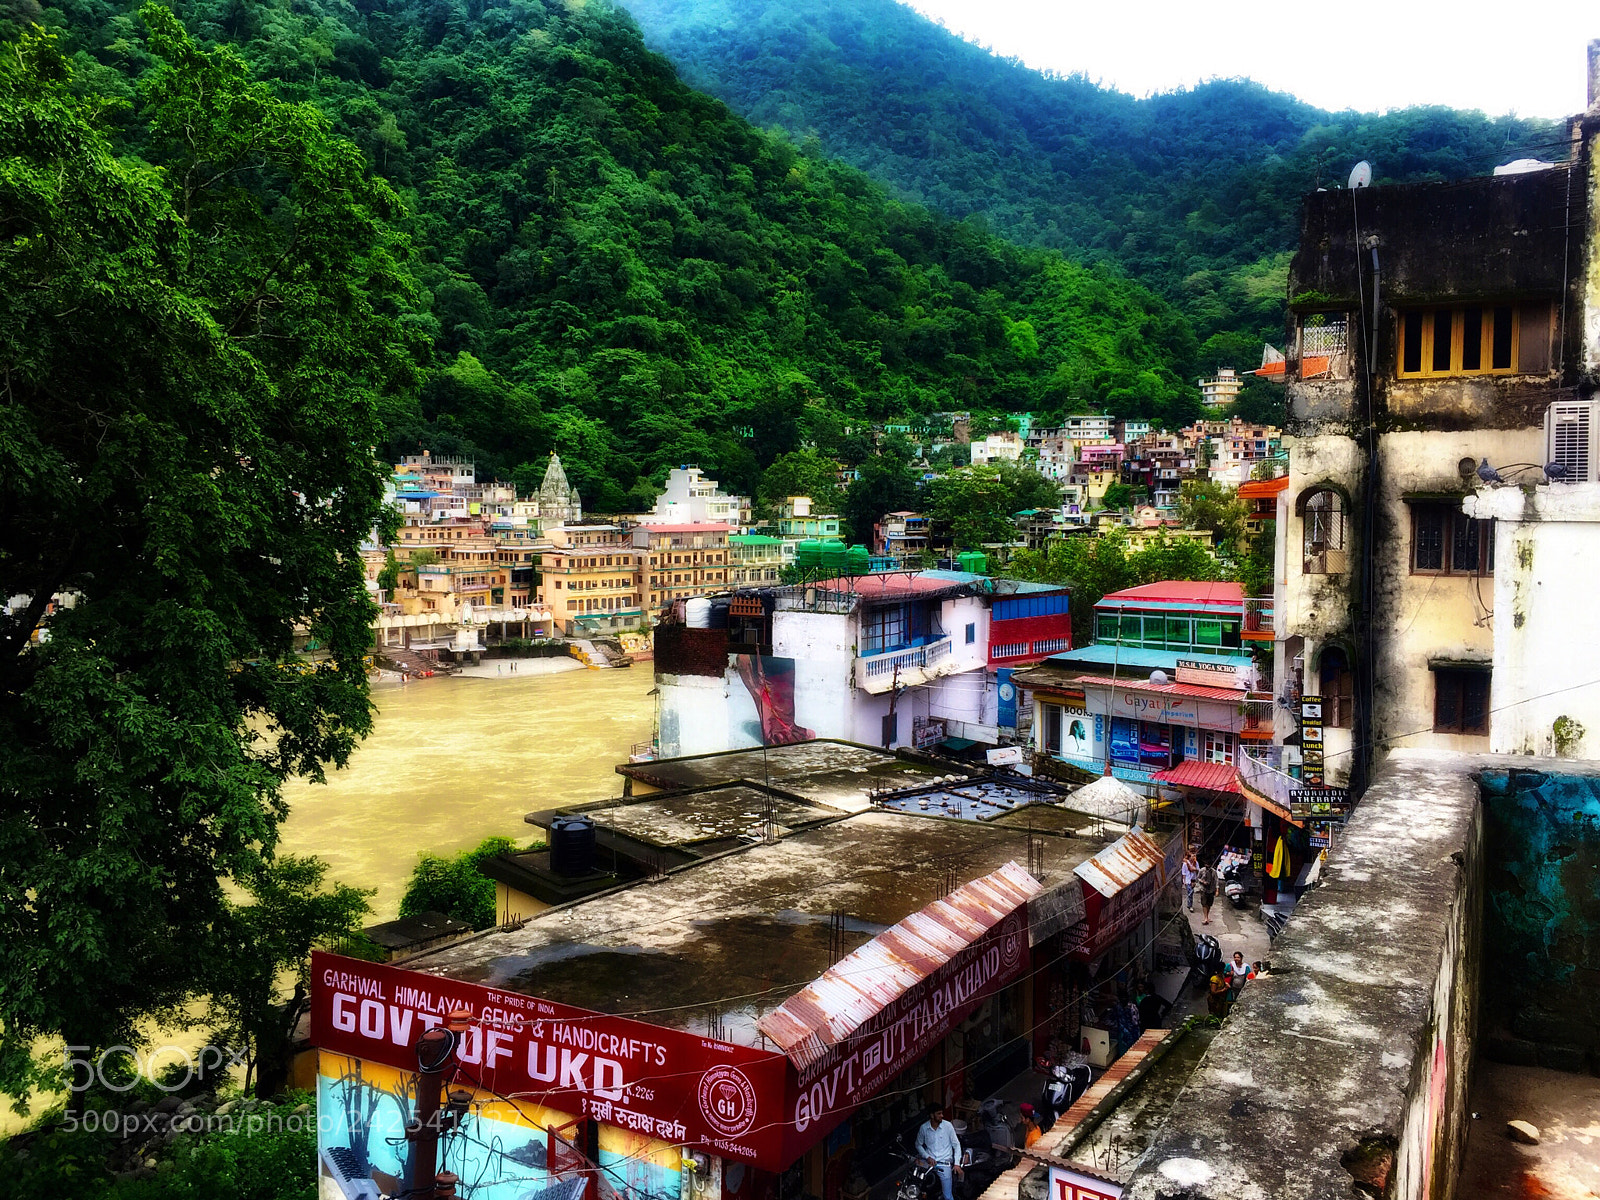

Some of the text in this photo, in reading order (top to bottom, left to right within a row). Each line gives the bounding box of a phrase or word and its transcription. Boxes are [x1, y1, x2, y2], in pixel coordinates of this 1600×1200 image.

[1198, 662, 1216, 672] YOGA
[1216, 664, 1238, 674] SCHOO
[1095, 713, 1104, 742] OOKS
[323, 969, 667, 1067] GARHWAL HIMALAYAN GEMS & HANDICRAFT'S
[487, 992, 555, 1016] THE PRIDE OF INDIA
[863, 1044, 881, 1073] OF
[882, 946, 1000, 1064] UTTARAKHAND
[456, 1024, 514, 1069] OF
[798, 1049, 842, 1088] GARHWAL
[848, 1001, 897, 1050] HIMALAYAN
[901, 982, 925, 1010] GEMS
[929, 974, 936, 988] &
[717, 1098, 735, 1118] GH
